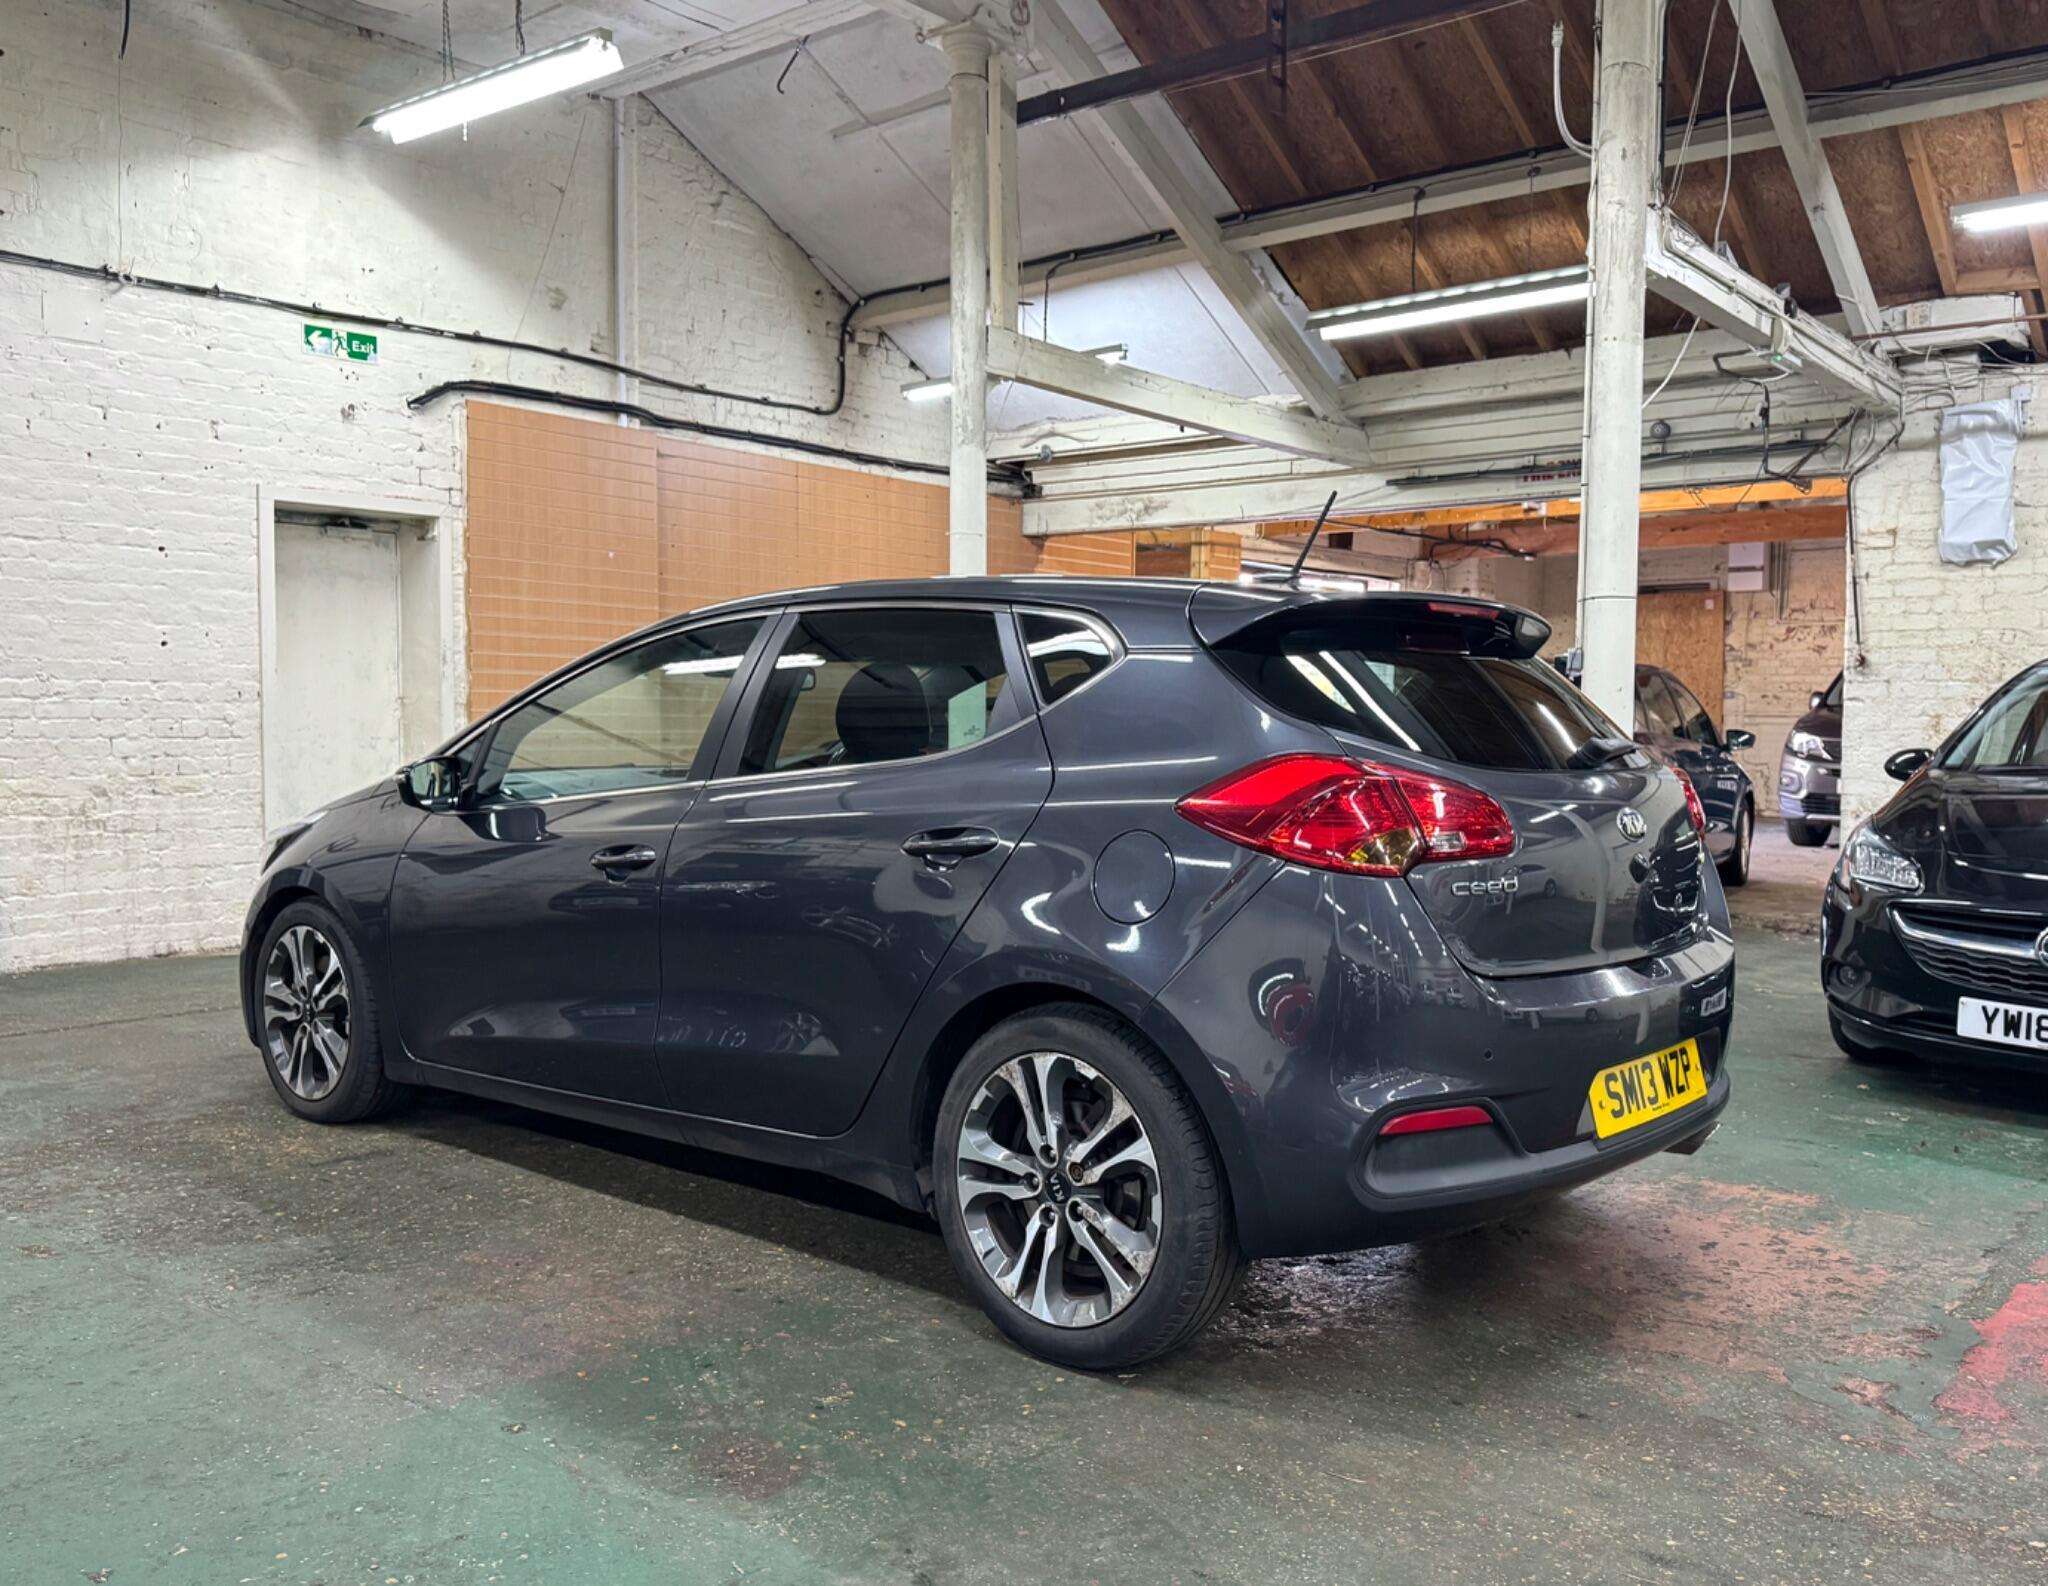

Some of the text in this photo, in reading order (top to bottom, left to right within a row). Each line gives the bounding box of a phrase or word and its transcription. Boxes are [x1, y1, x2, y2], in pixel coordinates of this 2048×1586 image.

[352, 339, 374, 354] Exit
[1604, 1045, 1691, 1119] SM13 WZP
